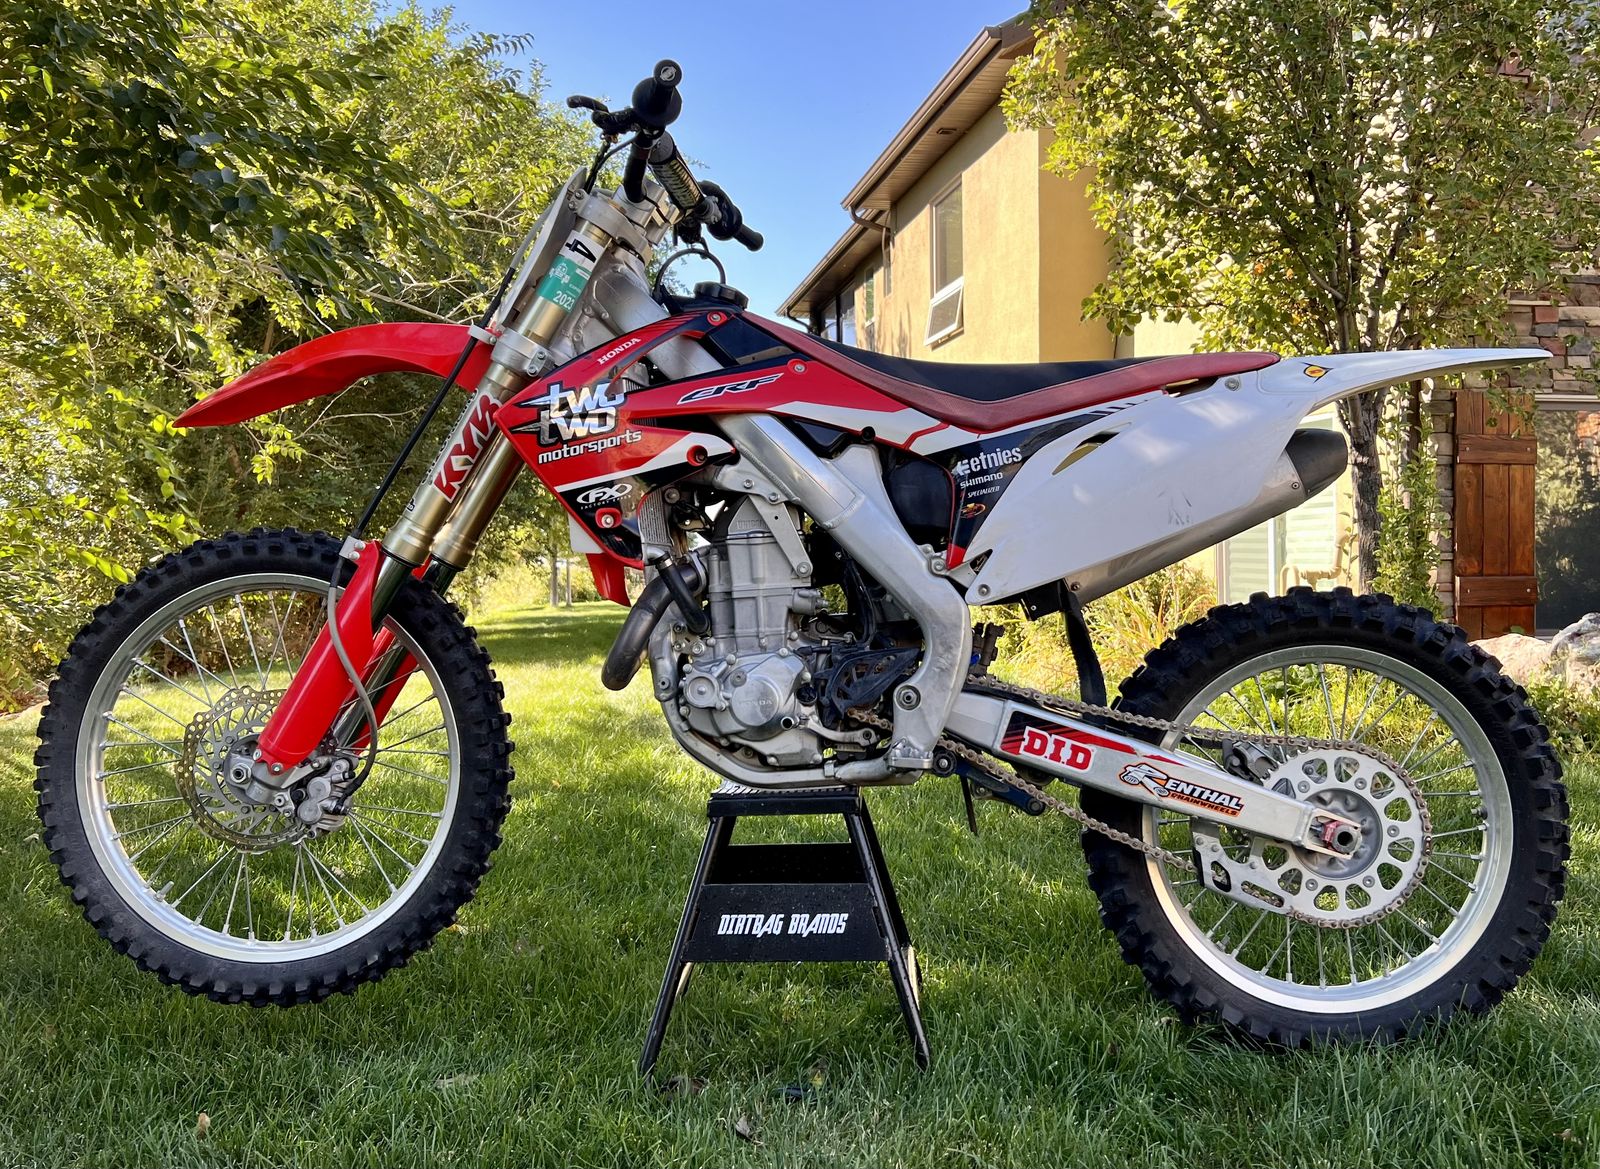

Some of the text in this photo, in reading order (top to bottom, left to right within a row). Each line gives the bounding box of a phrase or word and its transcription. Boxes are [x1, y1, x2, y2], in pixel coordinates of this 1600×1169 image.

[598, 337, 641, 366] HONDA
[677, 373, 784, 405] CRF
[433, 394, 502, 503] KYB
[538, 429, 642, 464] motorsports
[969, 447, 1023, 472] etnies
[960, 472, 1003, 489] SHIMANO
[1120, 764, 1243, 809] RENTHAL
[1171, 792, 1238, 816] CHAINWHEELS
[717, 913, 848, 938] DIRTBAG BRANDS
